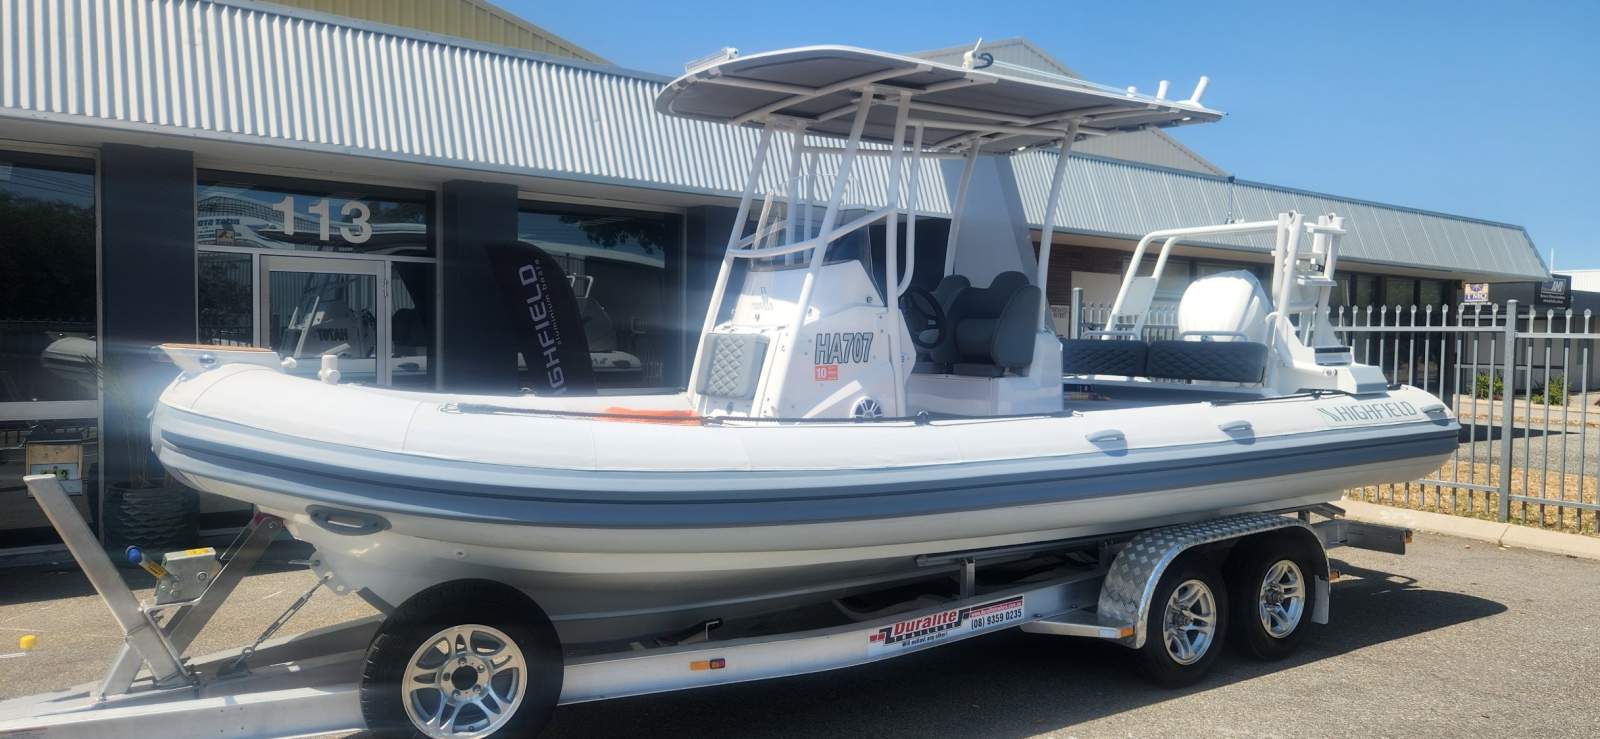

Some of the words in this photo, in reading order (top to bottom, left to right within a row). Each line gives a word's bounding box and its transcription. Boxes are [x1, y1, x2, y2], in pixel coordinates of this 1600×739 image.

[272, 196, 373, 244] 113
[518, 264, 568, 396] IGHFIELD
[815, 332, 874, 365] HA707
[816, 367, 828, 378] 10
[1333, 401, 1418, 422] HIGHFIELD
[894, 609, 957, 636] Duralite
[971, 617, 985, 630] (08)
[986, 613, 1004, 625] 9359
[1005, 608, 1022, 621] 0235
